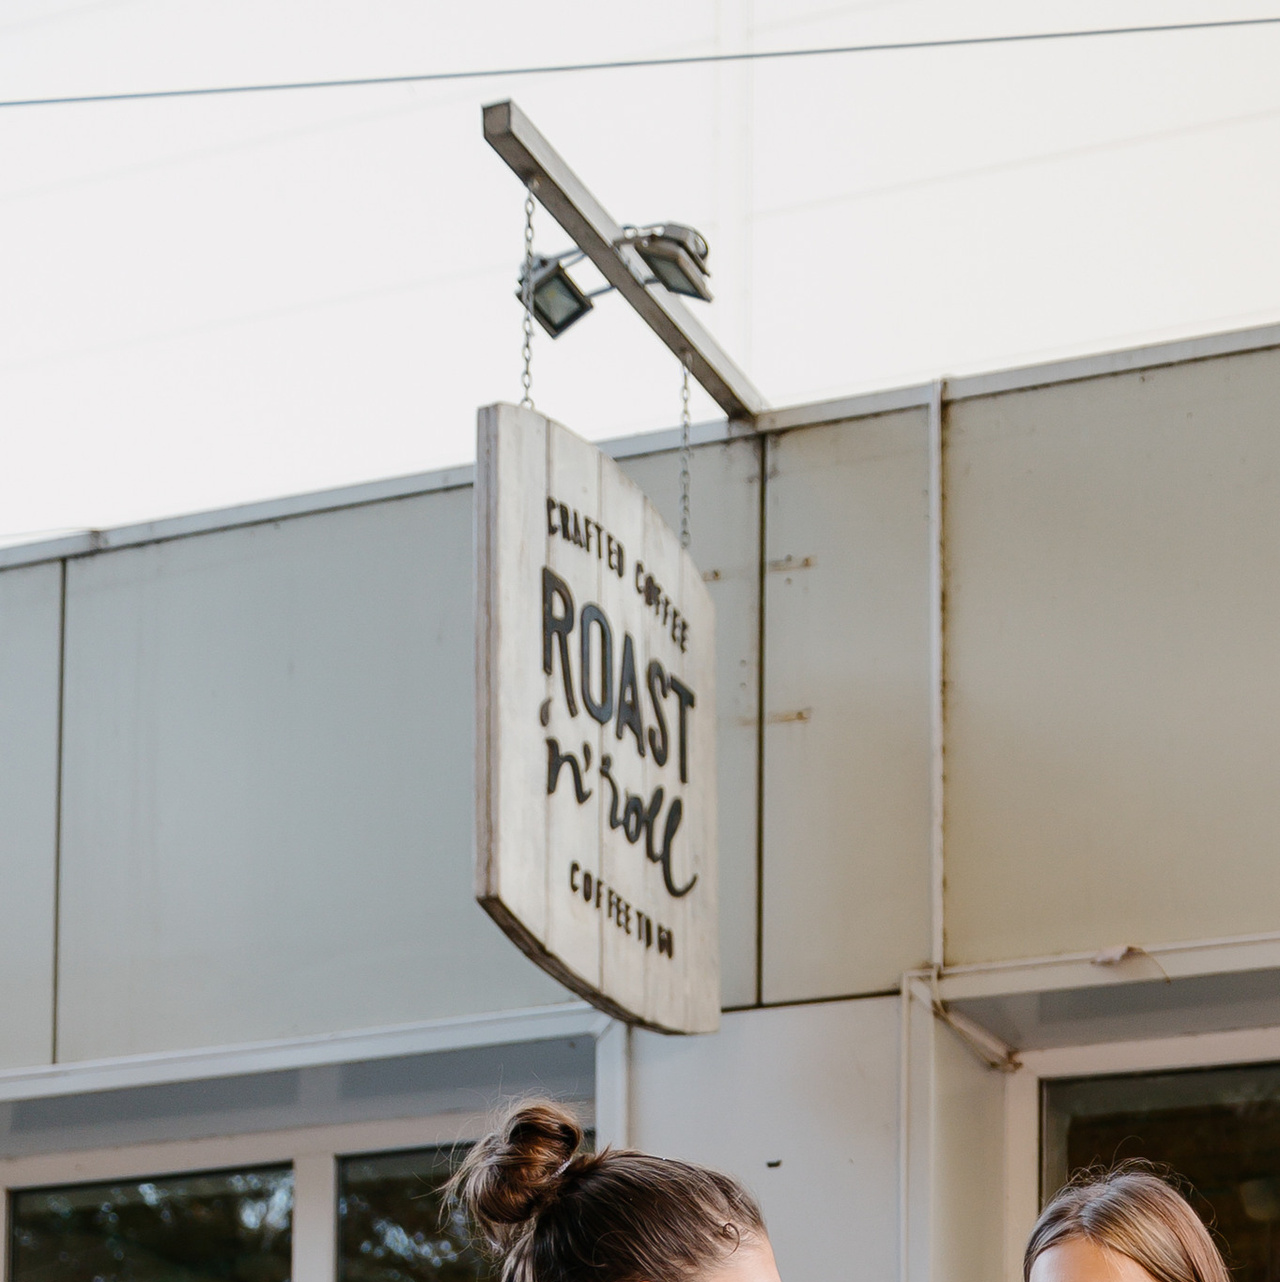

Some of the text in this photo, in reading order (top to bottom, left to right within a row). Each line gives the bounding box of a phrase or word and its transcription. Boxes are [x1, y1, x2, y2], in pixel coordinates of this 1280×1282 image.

[547, 496, 689, 653] CRAFTED COFFEE
[542, 566, 695, 784] ROAST
[570, 861, 632, 935] COFFEE
[636, 910, 653, 949] TO
